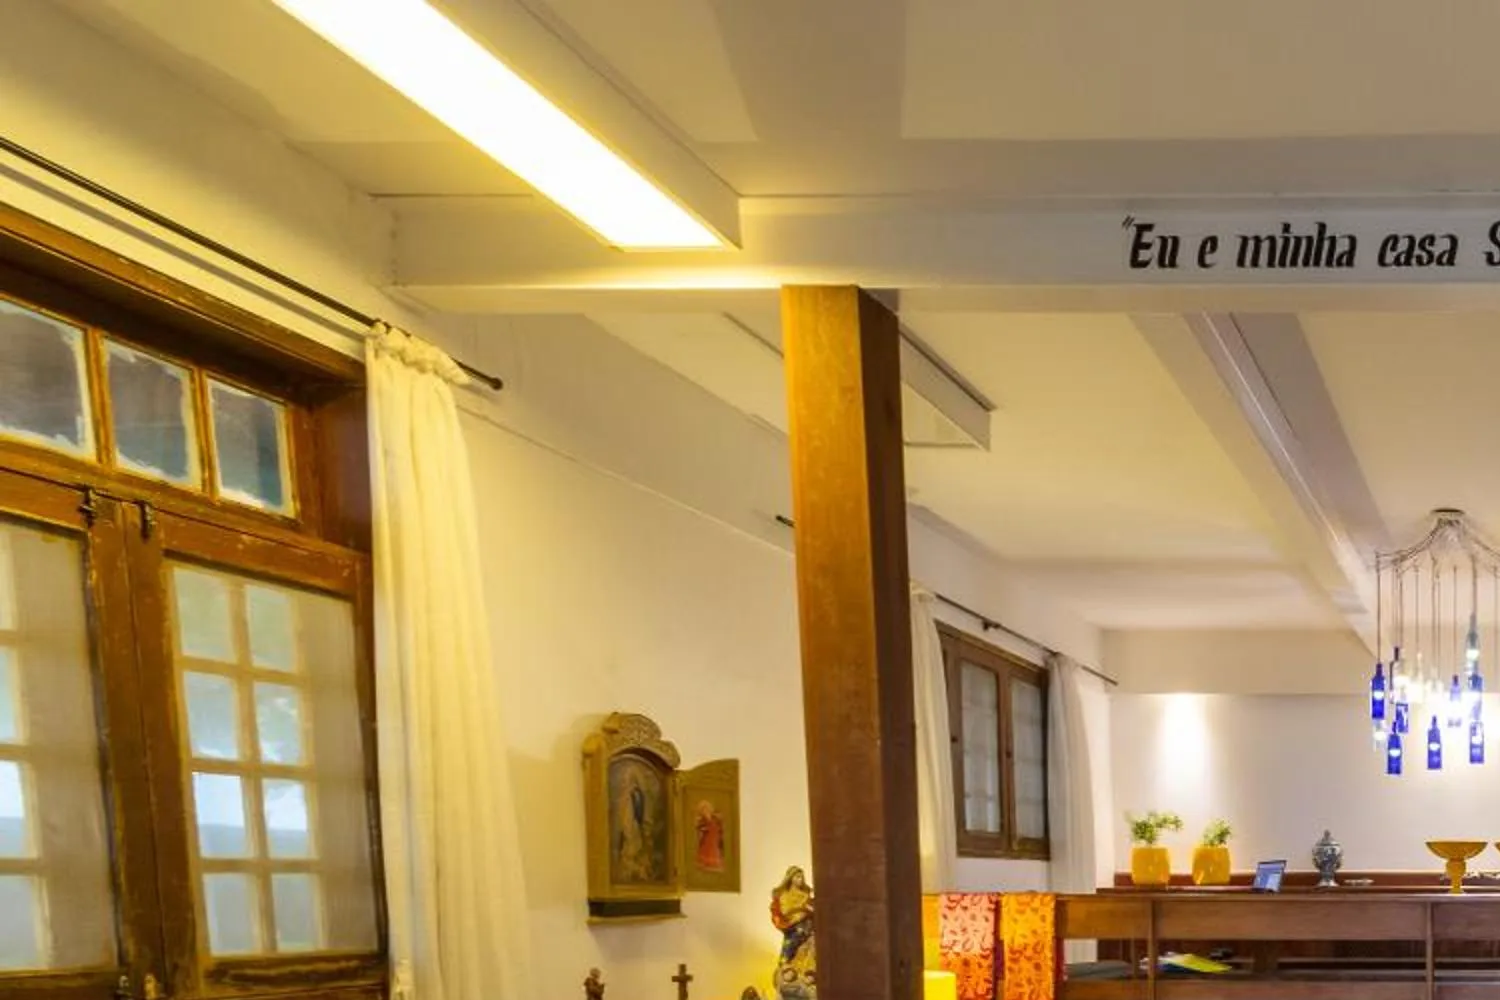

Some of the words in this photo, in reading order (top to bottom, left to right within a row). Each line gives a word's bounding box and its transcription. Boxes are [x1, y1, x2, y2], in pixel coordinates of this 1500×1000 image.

[1198, 236, 1218, 268] e
[1237, 222, 1357, 268] minha
[1378, 234, 1458, 267] casa
